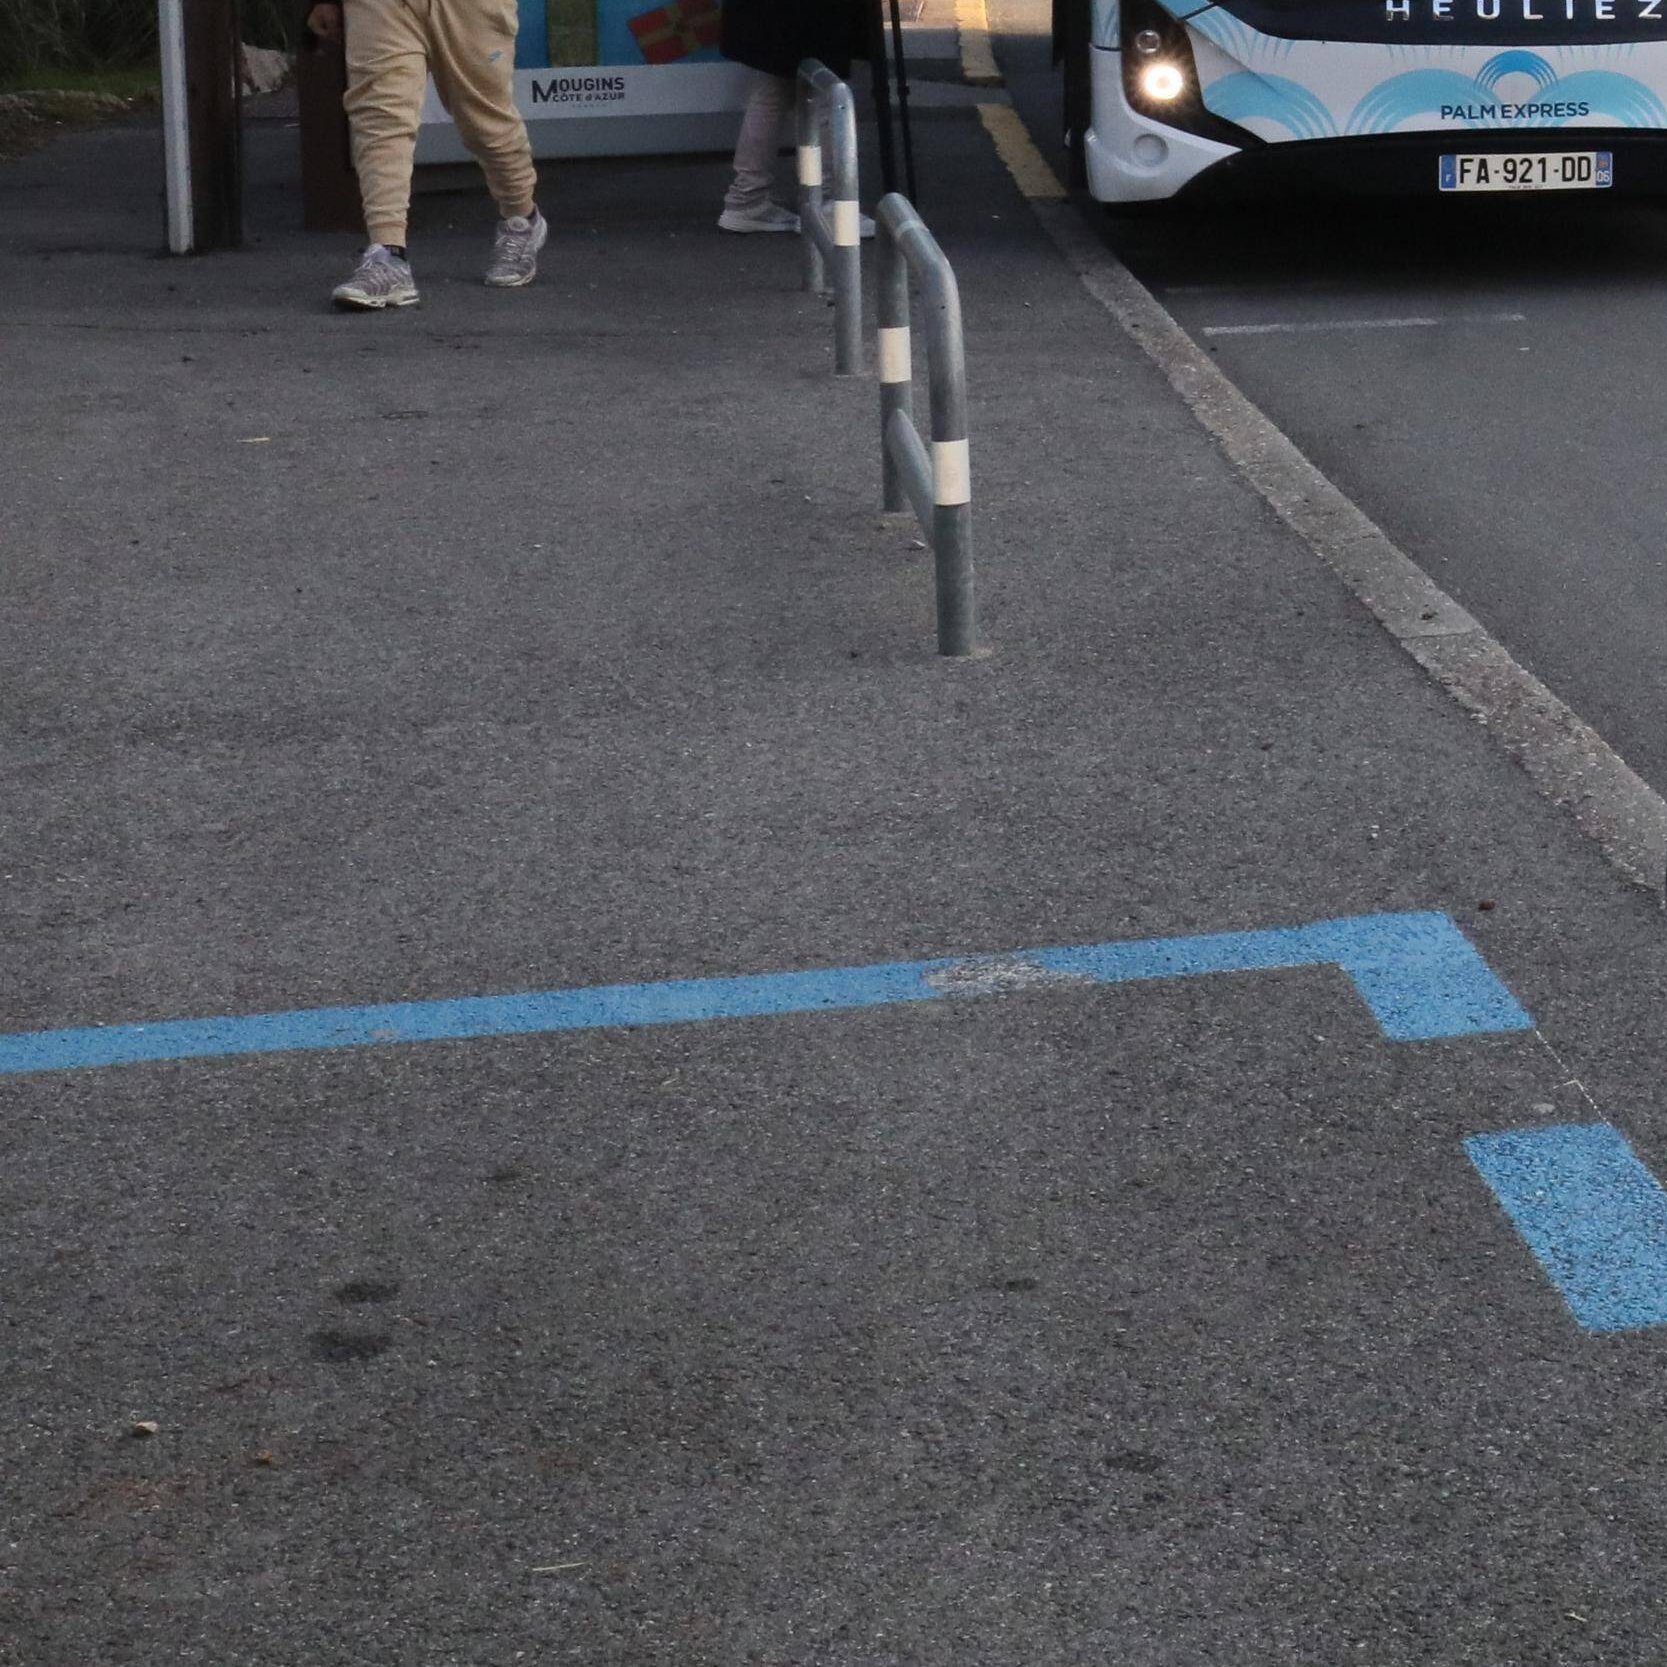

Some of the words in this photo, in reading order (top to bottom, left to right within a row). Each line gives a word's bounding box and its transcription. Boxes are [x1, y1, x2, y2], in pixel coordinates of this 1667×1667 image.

[532, 77, 625, 103] MOUGINS
[1441, 104, 1496, 120] PALM
[1500, 102, 1590, 118] EXPRESS
[1459, 155, 1592, 184] FA-921-DD
[1595, 169, 1611, 183] 06
